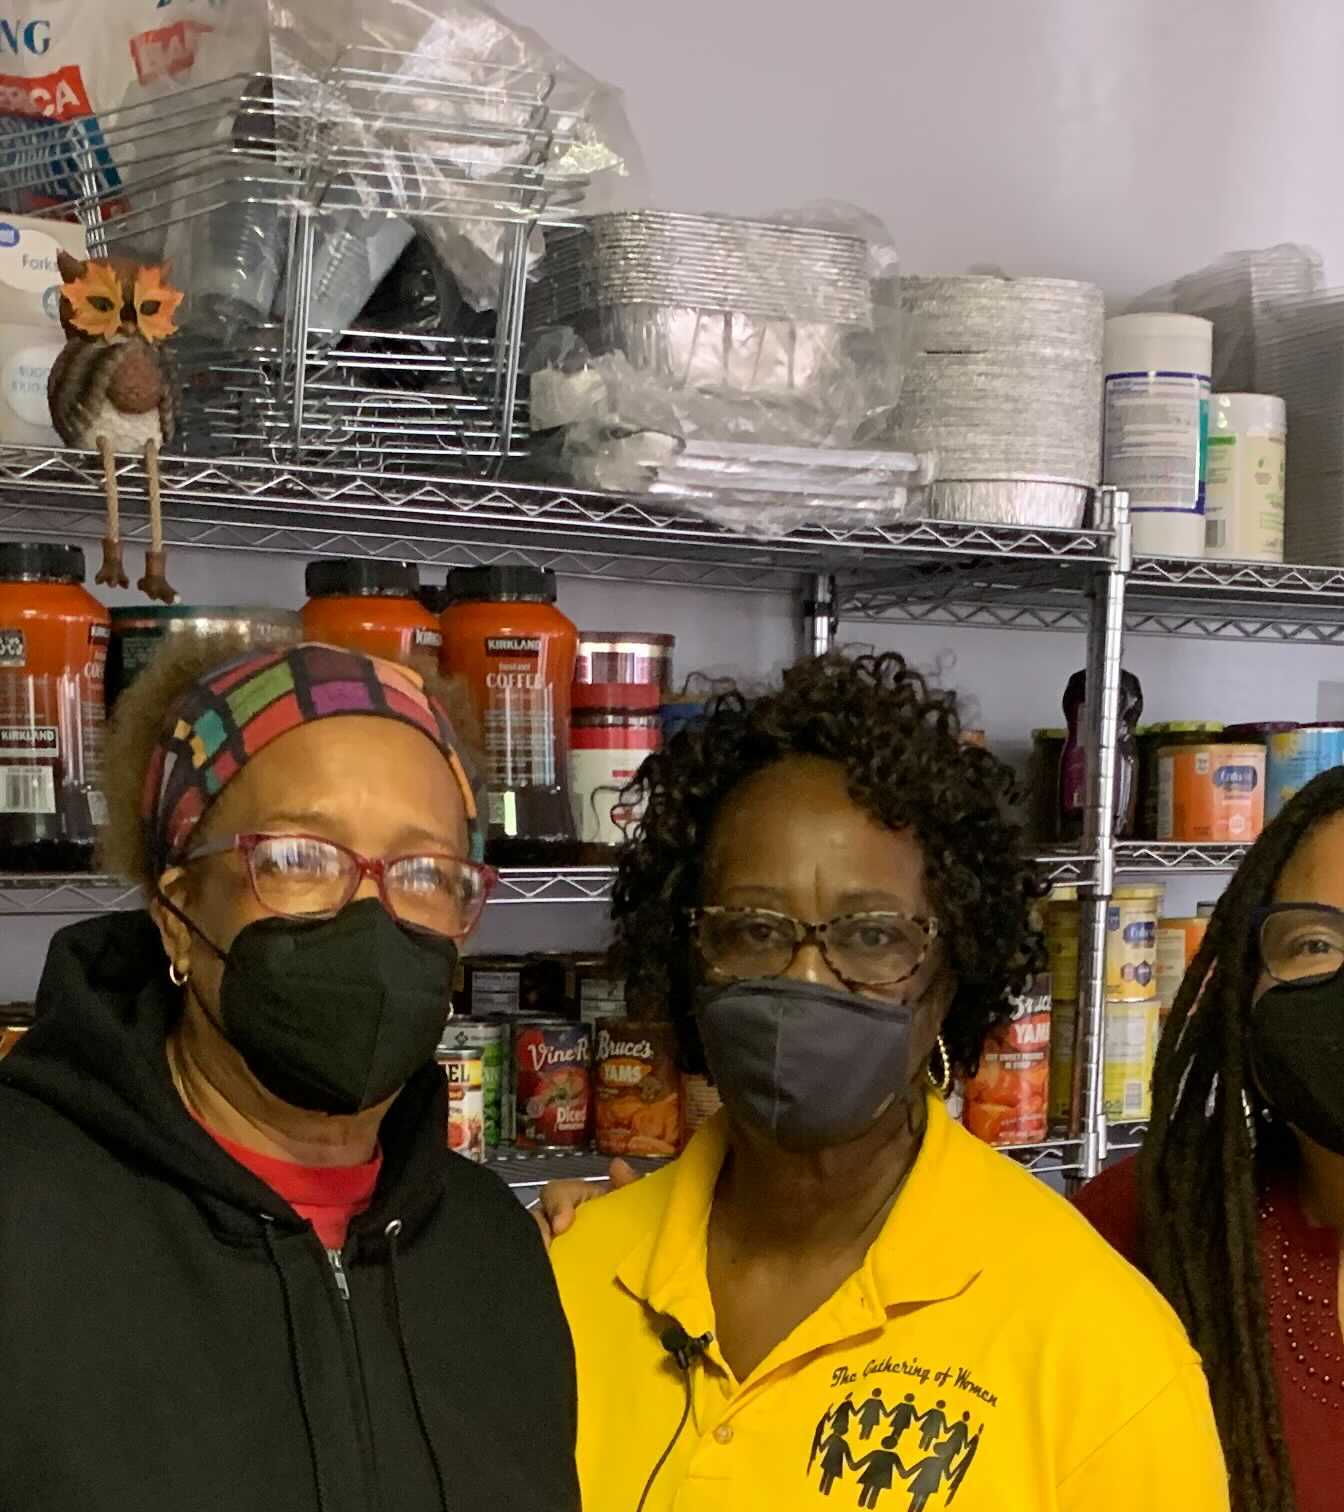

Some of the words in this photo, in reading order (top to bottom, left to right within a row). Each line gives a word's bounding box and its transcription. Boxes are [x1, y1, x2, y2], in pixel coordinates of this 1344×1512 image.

[487, 638, 542, 652] KIRKLAND
[486, 672, 542, 690] COFFEE
[0, 728, 55, 742] KIRKLAND
[830, 1366, 857, 1388] The
[863, 1356, 930, 1385] Gathering
[934, 1366, 953, 1387] of
[954, 1367, 998, 1408] Women
